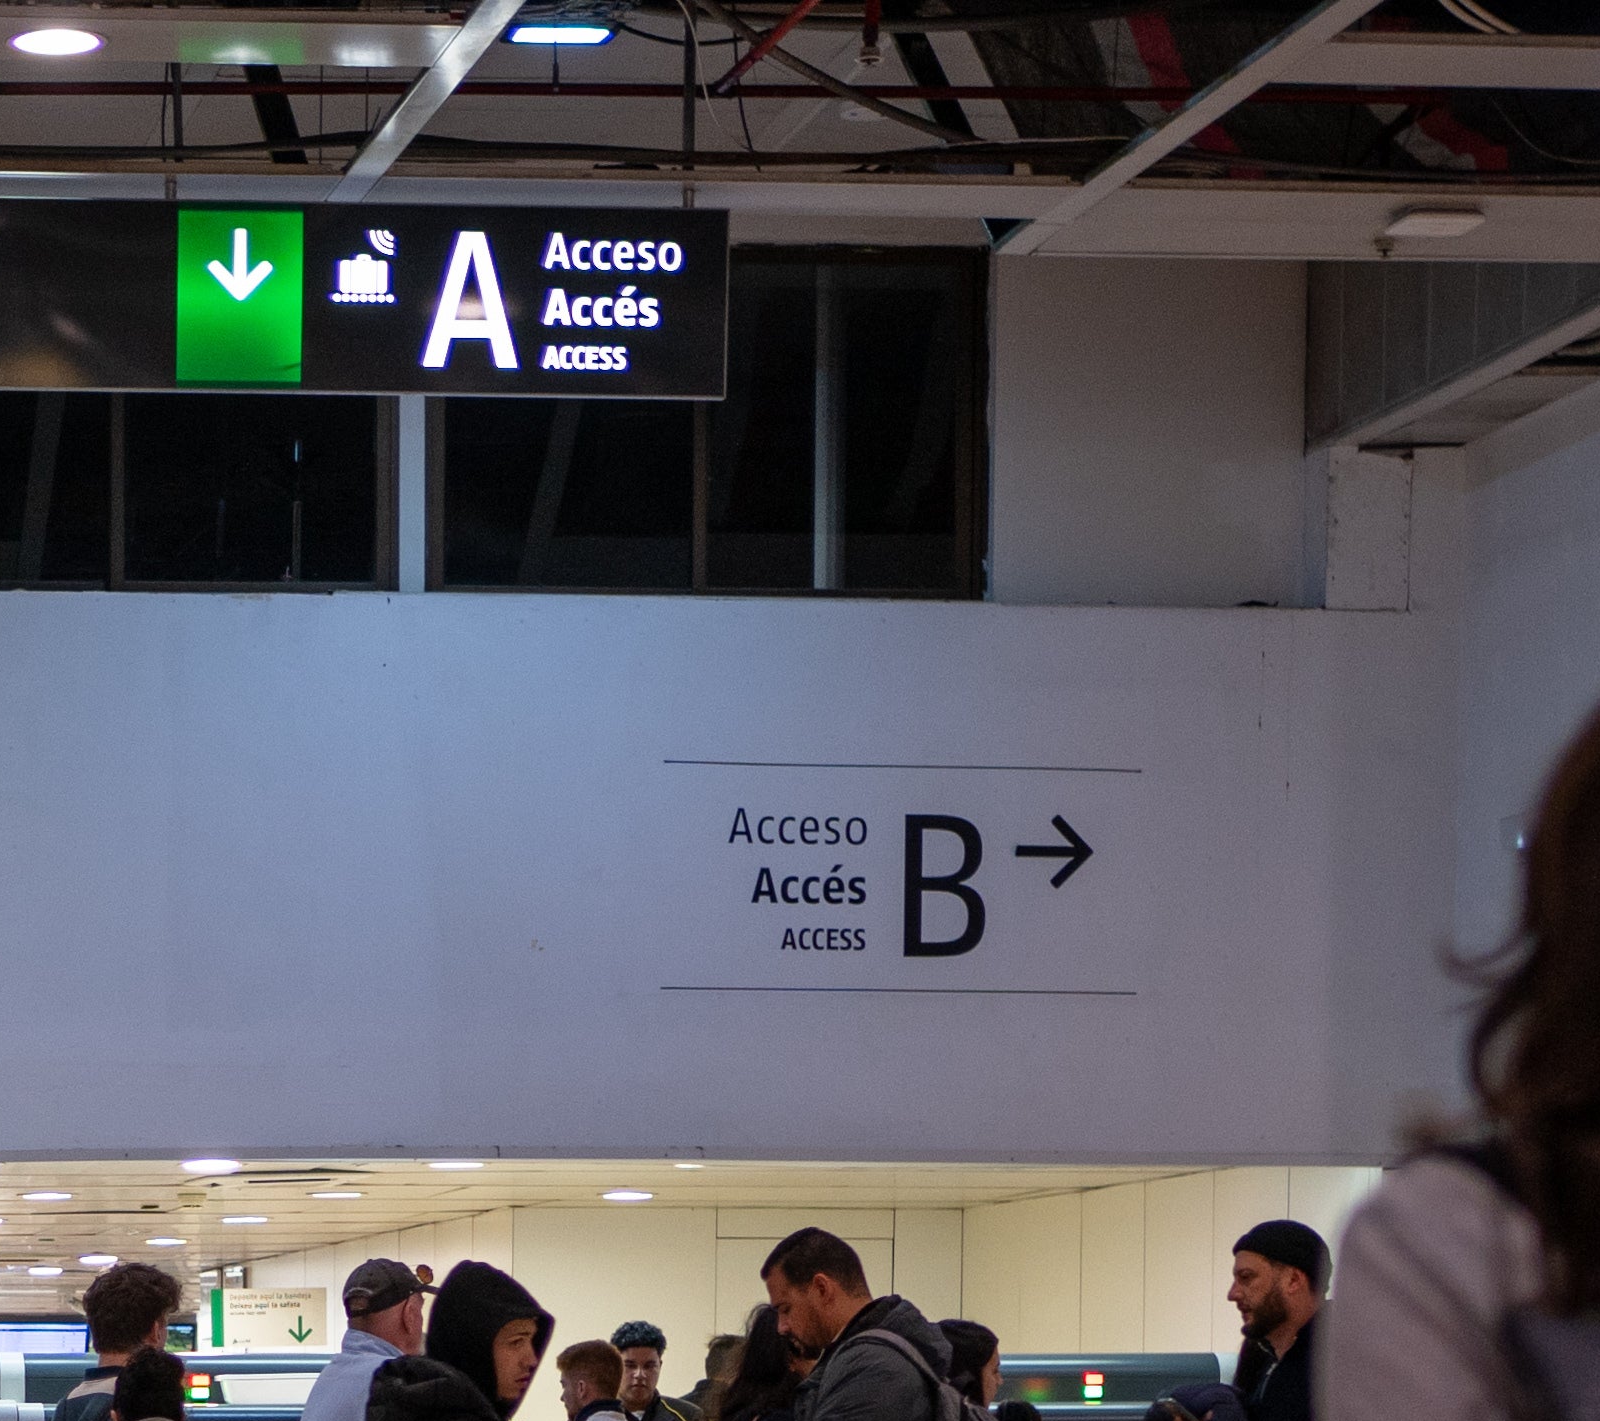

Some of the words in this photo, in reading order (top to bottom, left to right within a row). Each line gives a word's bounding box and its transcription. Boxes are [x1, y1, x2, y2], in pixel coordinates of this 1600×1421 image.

[543, 231, 684, 272] Acceso
[421, 230, 520, 369] A
[541, 285, 661, 328] Accés
[541, 345, 629, 371] ACCESS
[728, 807, 868, 846] Acceso
[751, 864, 867, 905] Accés
[903, 813, 987, 957] B
[780, 927, 866, 951] ACCESS
